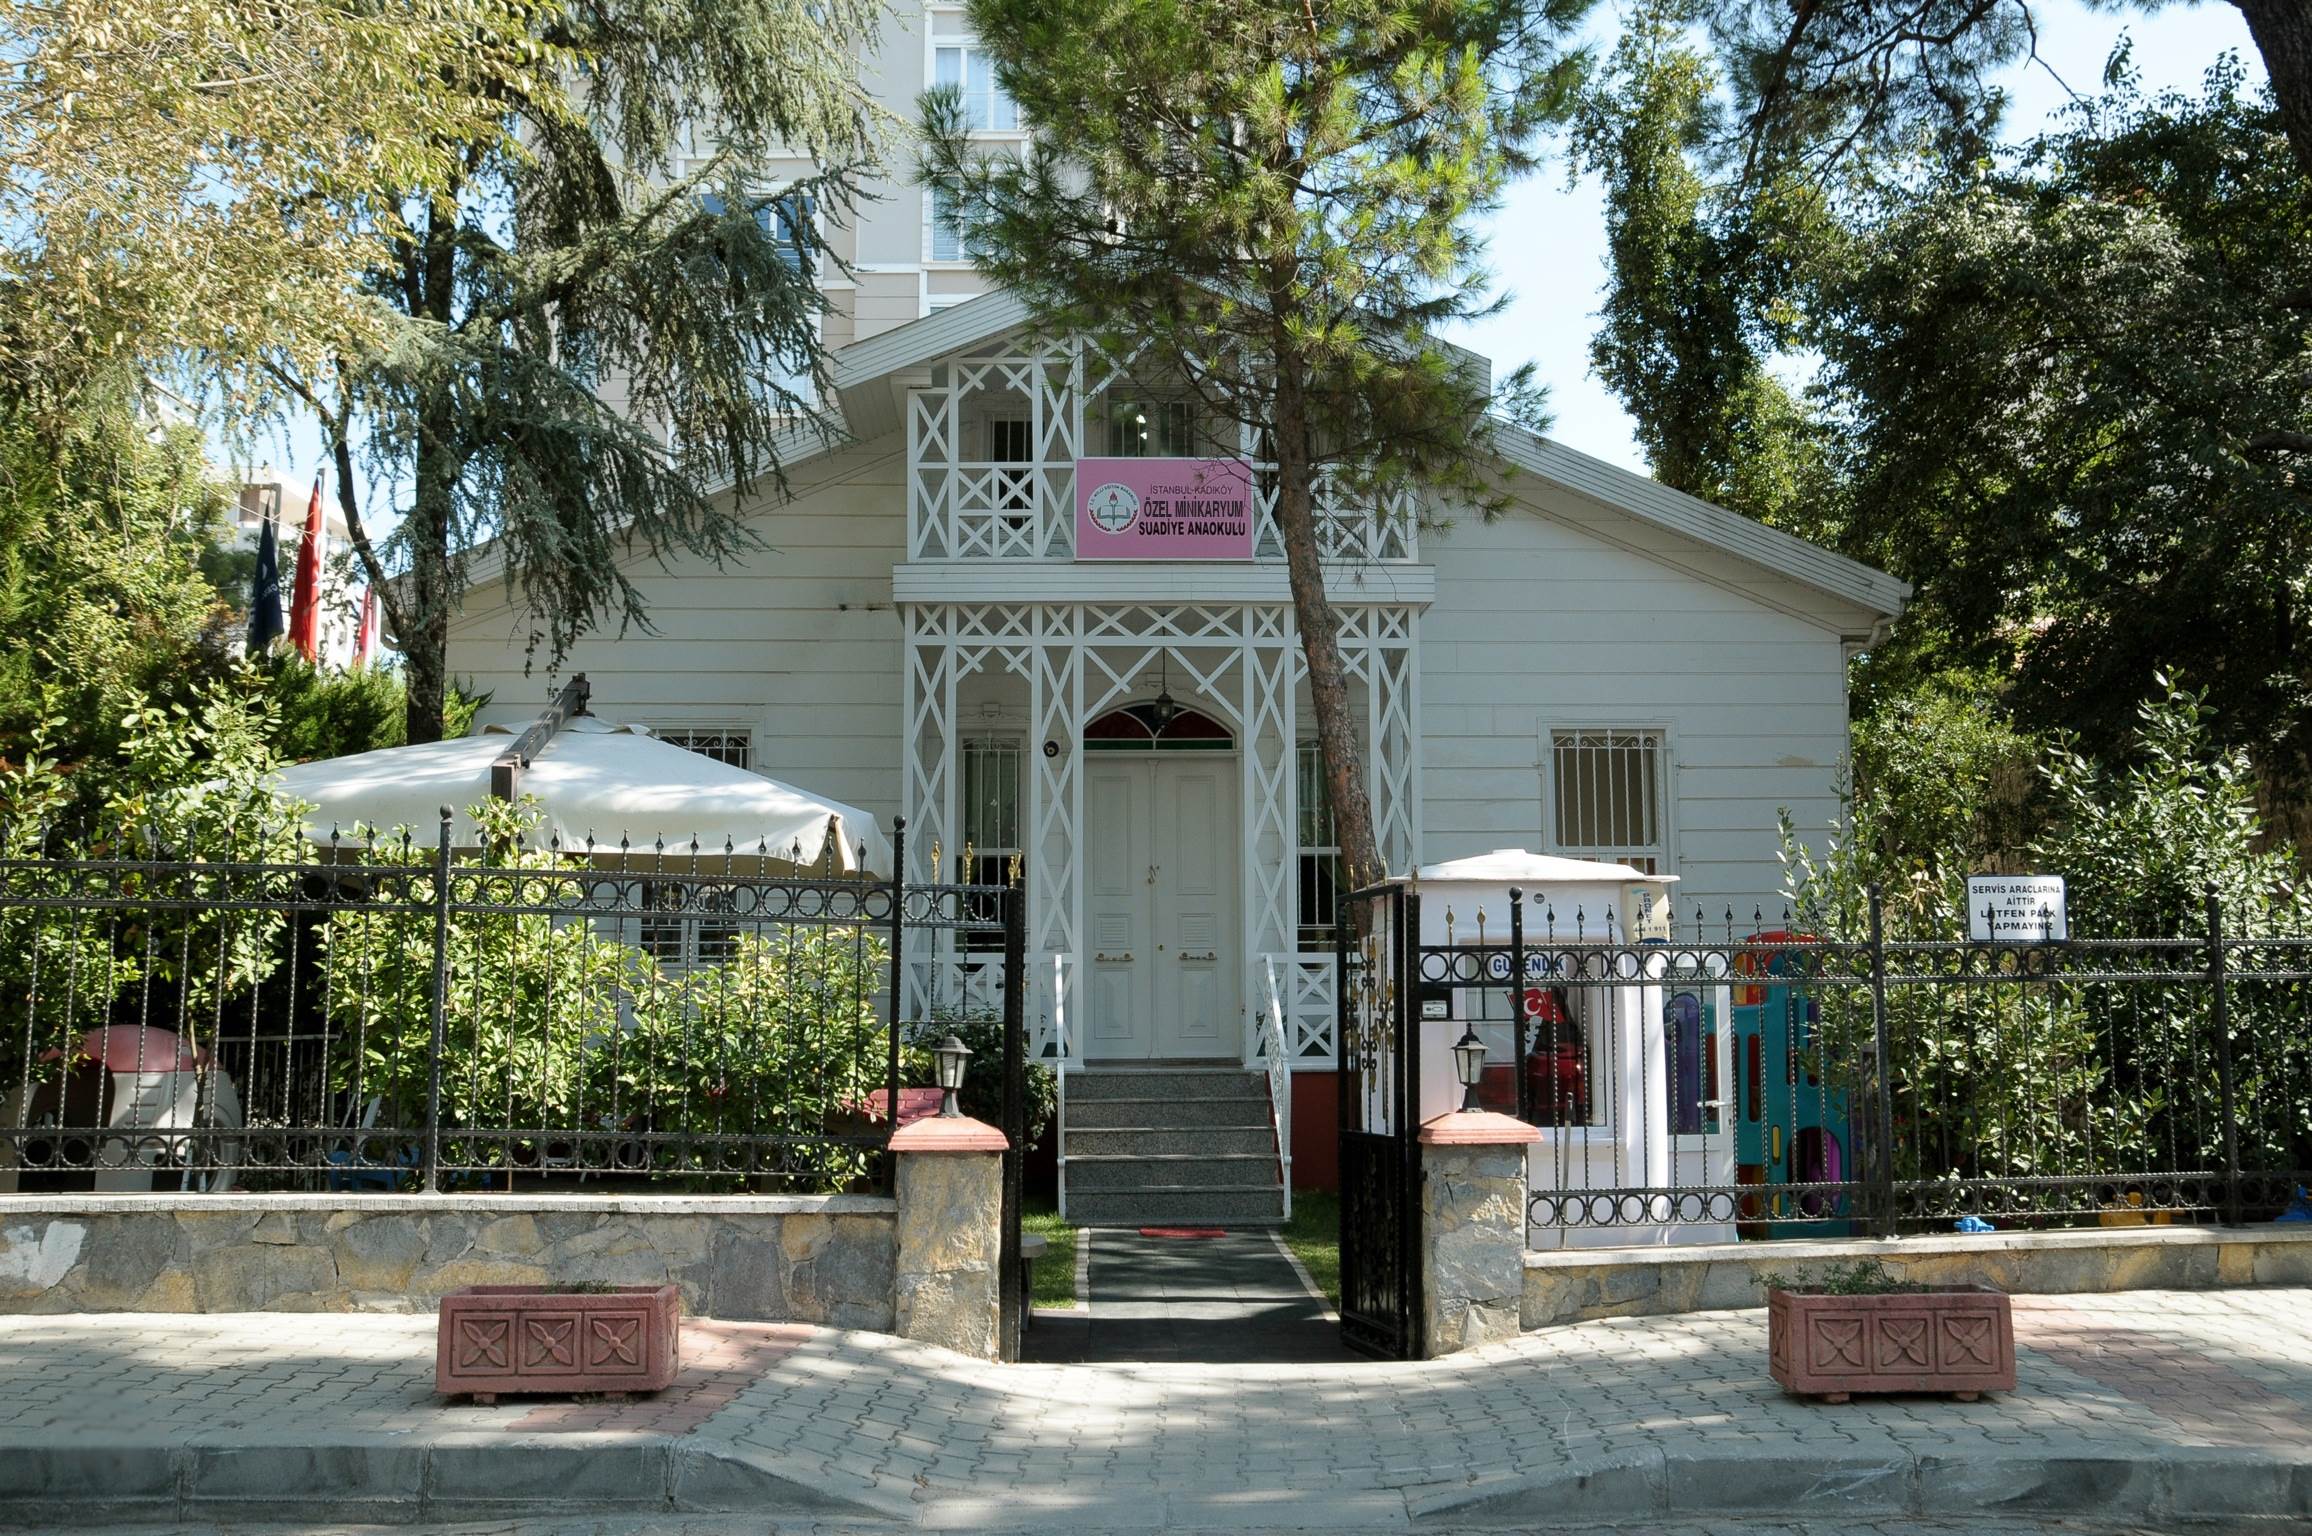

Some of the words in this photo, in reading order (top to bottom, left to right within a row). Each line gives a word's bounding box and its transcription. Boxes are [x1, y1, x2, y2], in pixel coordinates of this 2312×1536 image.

[1144, 497, 1173, 518] ÖZEL
[1175, 496, 1243, 518] MİNİKARYUM
[1138, 519, 1184, 536] SUADİYE
[1188, 521, 1246, 536] ANAOKULU
[1972, 883, 2006, 894] SERVİS
[2006, 895, 2035, 905] AİTTİR
[1980, 909, 2025, 918] LTFEN
[2030, 909, 2056, 918] PAK
[1987, 922, 2053, 930] APMAYINZ
[1493, 955, 1564, 972] GÜENLK
